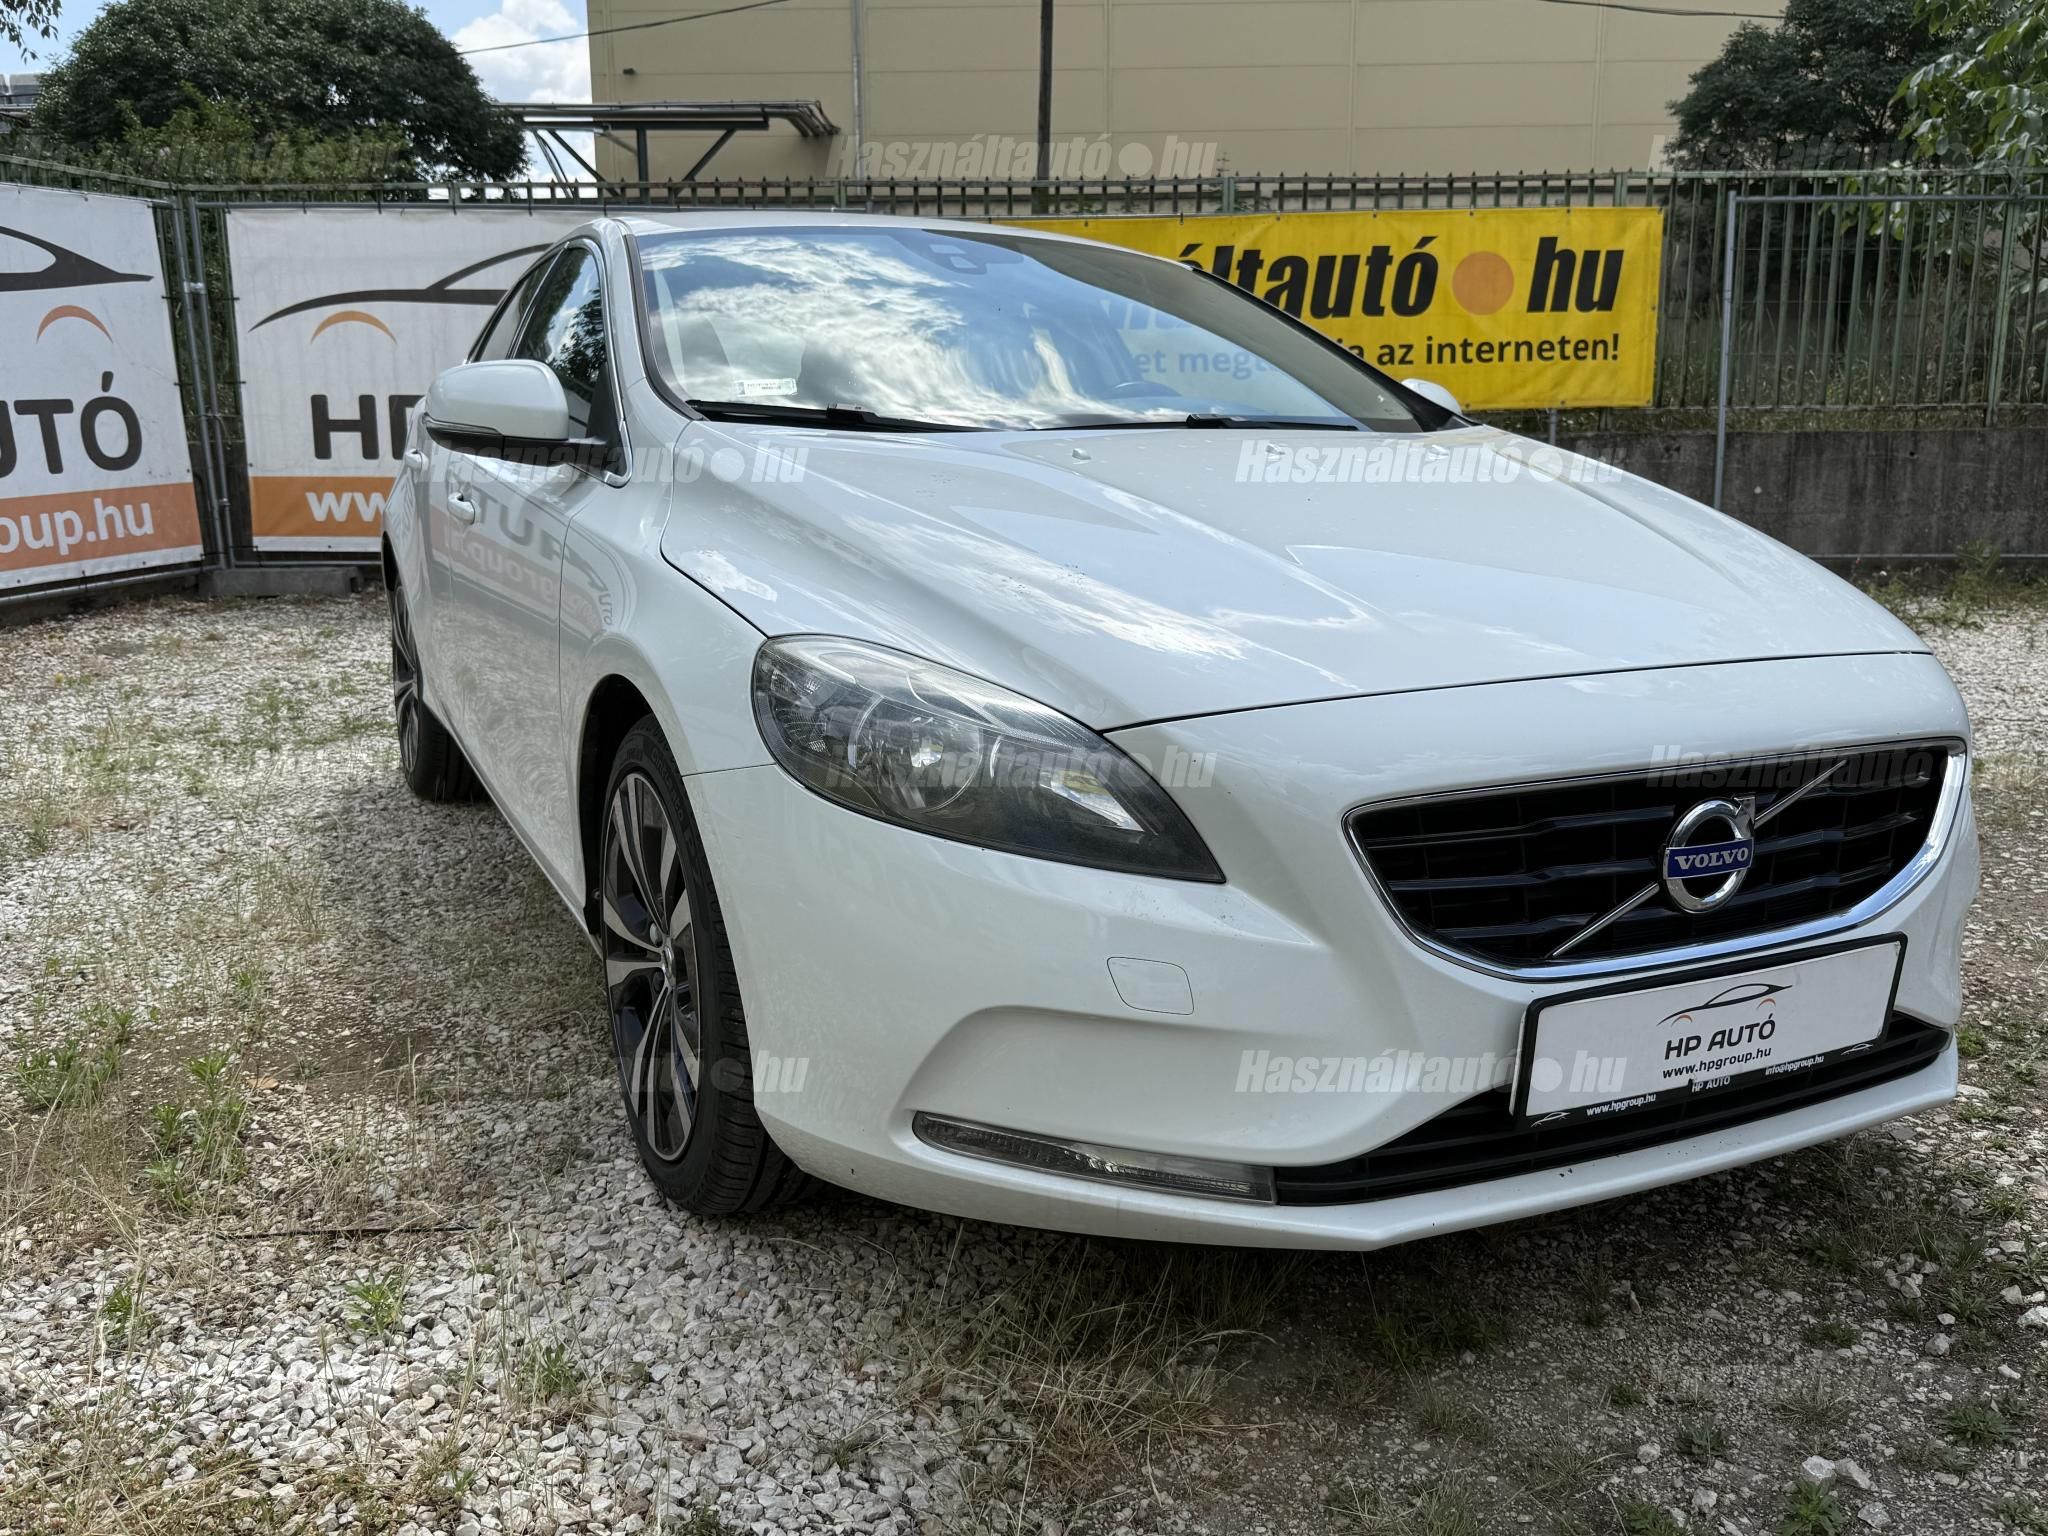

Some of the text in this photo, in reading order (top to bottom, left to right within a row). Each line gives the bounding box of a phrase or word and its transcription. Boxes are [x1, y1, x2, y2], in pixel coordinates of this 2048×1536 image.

[1526, 236, 1624, 312] hu
[1376, 342, 1415, 366] az
[1425, 333, 1620, 365] interneten!
[1675, 847, 1749, 870] VOLVO
[1665, 1013, 1776, 1061] HP AUTÓ
[1662, 1047, 1772, 1079] www.hpgroup.hu
[1586, 1093, 1657, 1117] www.hpgroup.hu
